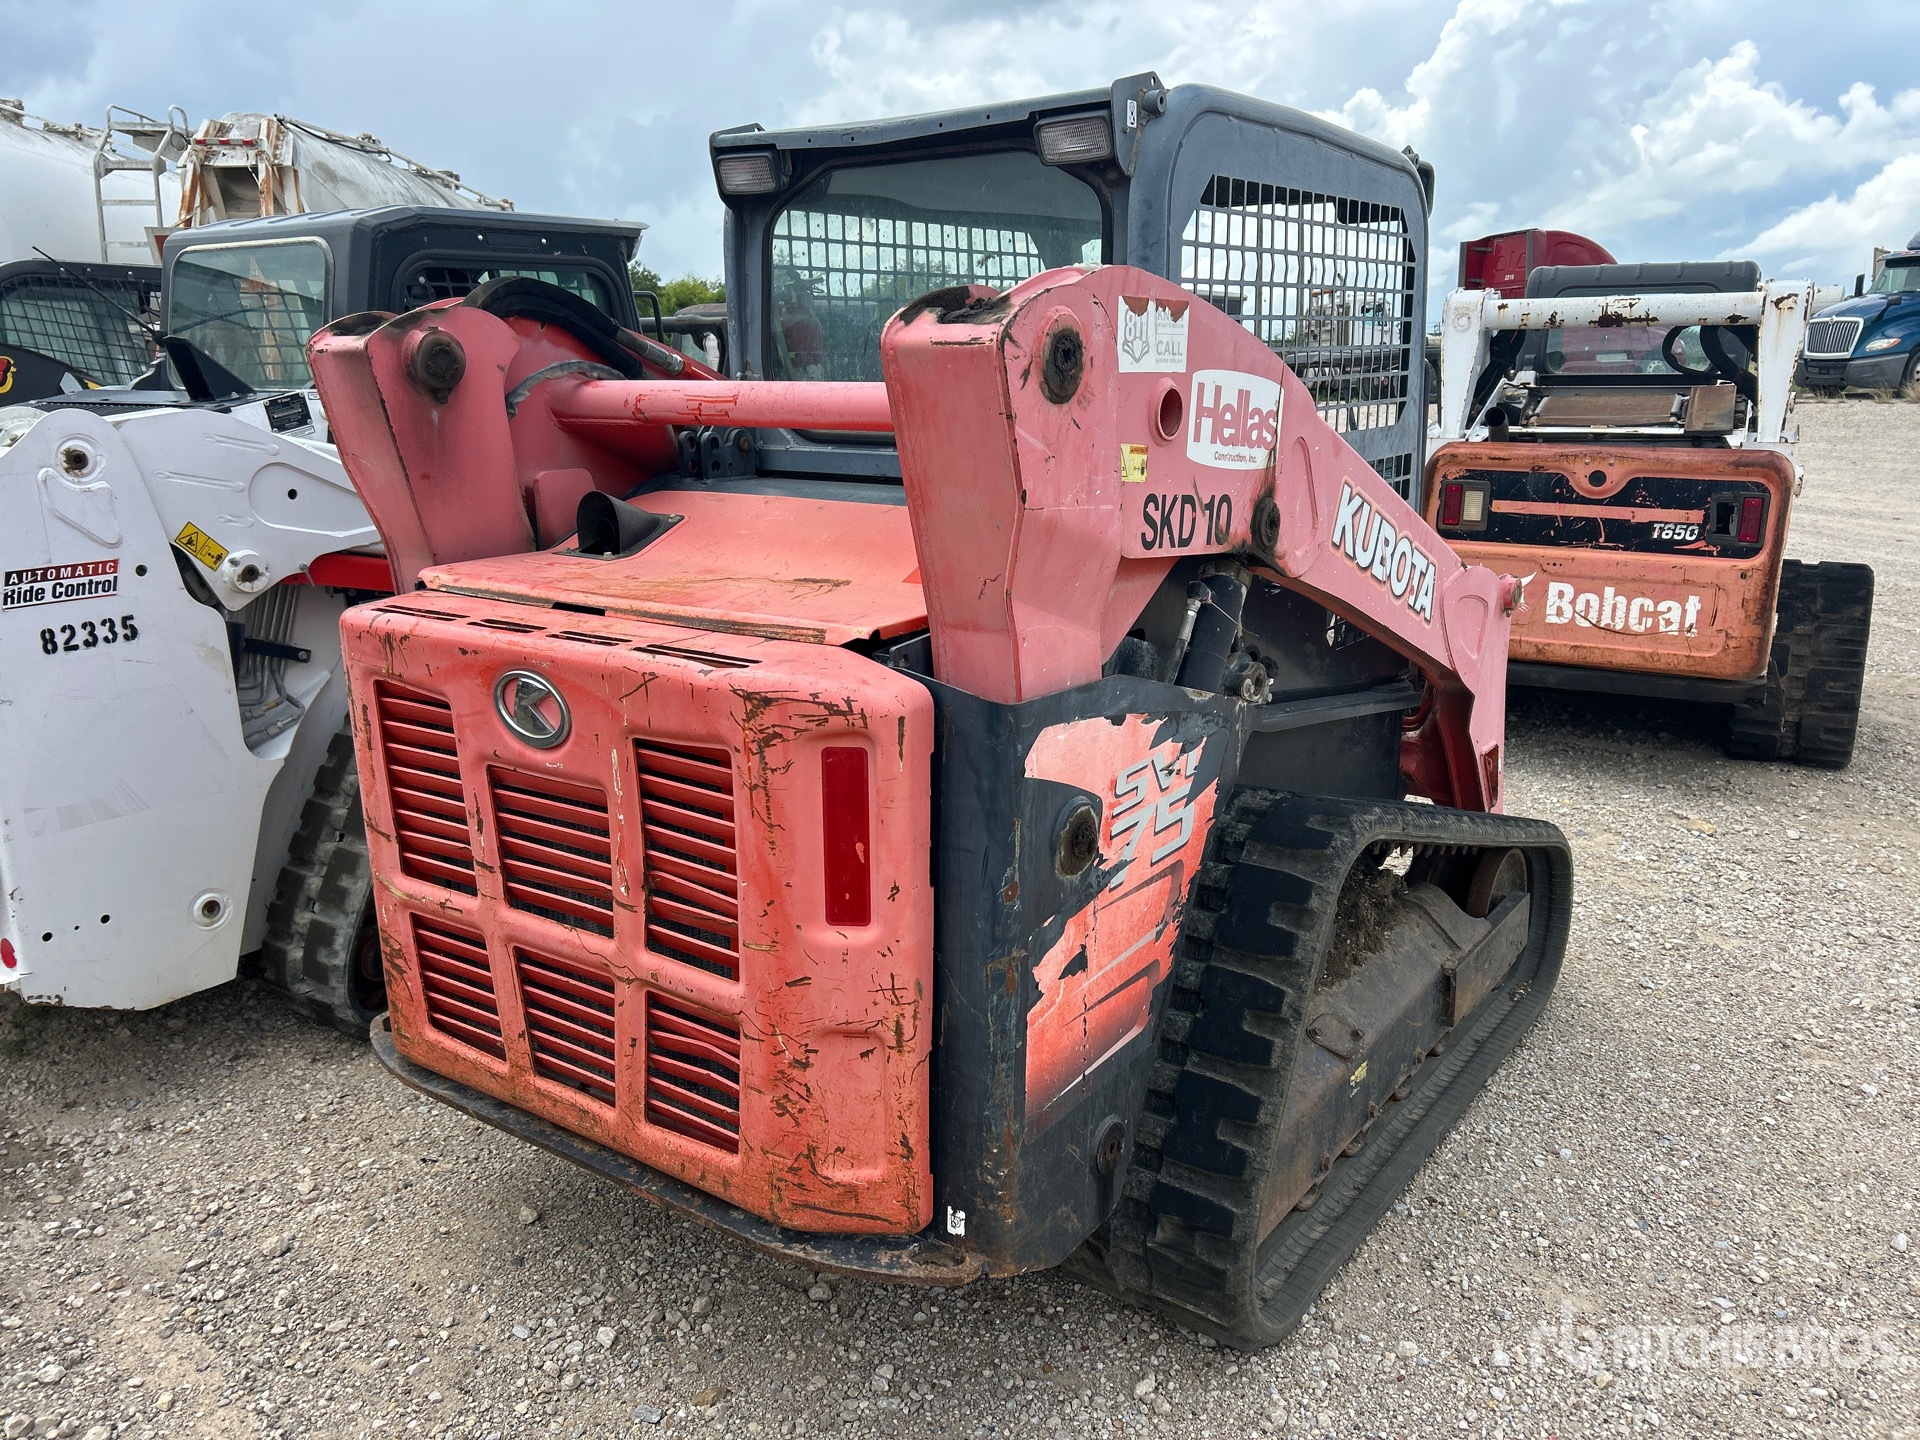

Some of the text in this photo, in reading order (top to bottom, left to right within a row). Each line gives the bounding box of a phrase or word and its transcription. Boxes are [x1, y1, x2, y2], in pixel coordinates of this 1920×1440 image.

[1156, 340, 1183, 356] CALL
[1193, 382, 1278, 450] Hellas
[1214, 451, 1258, 463] Construction, Inc.
[1141, 493, 1232, 550] SKD 10
[1652, 523, 1699, 541] T650
[9, 561, 115, 585] AUTOMATIC
[1332, 483, 1436, 622] KUBOTA
[2, 575, 118, 606] Ride Control
[1545, 581, 1702, 638] Bobcat
[40, 614, 138, 655] 82335
[1108, 782, 1195, 893] 75
